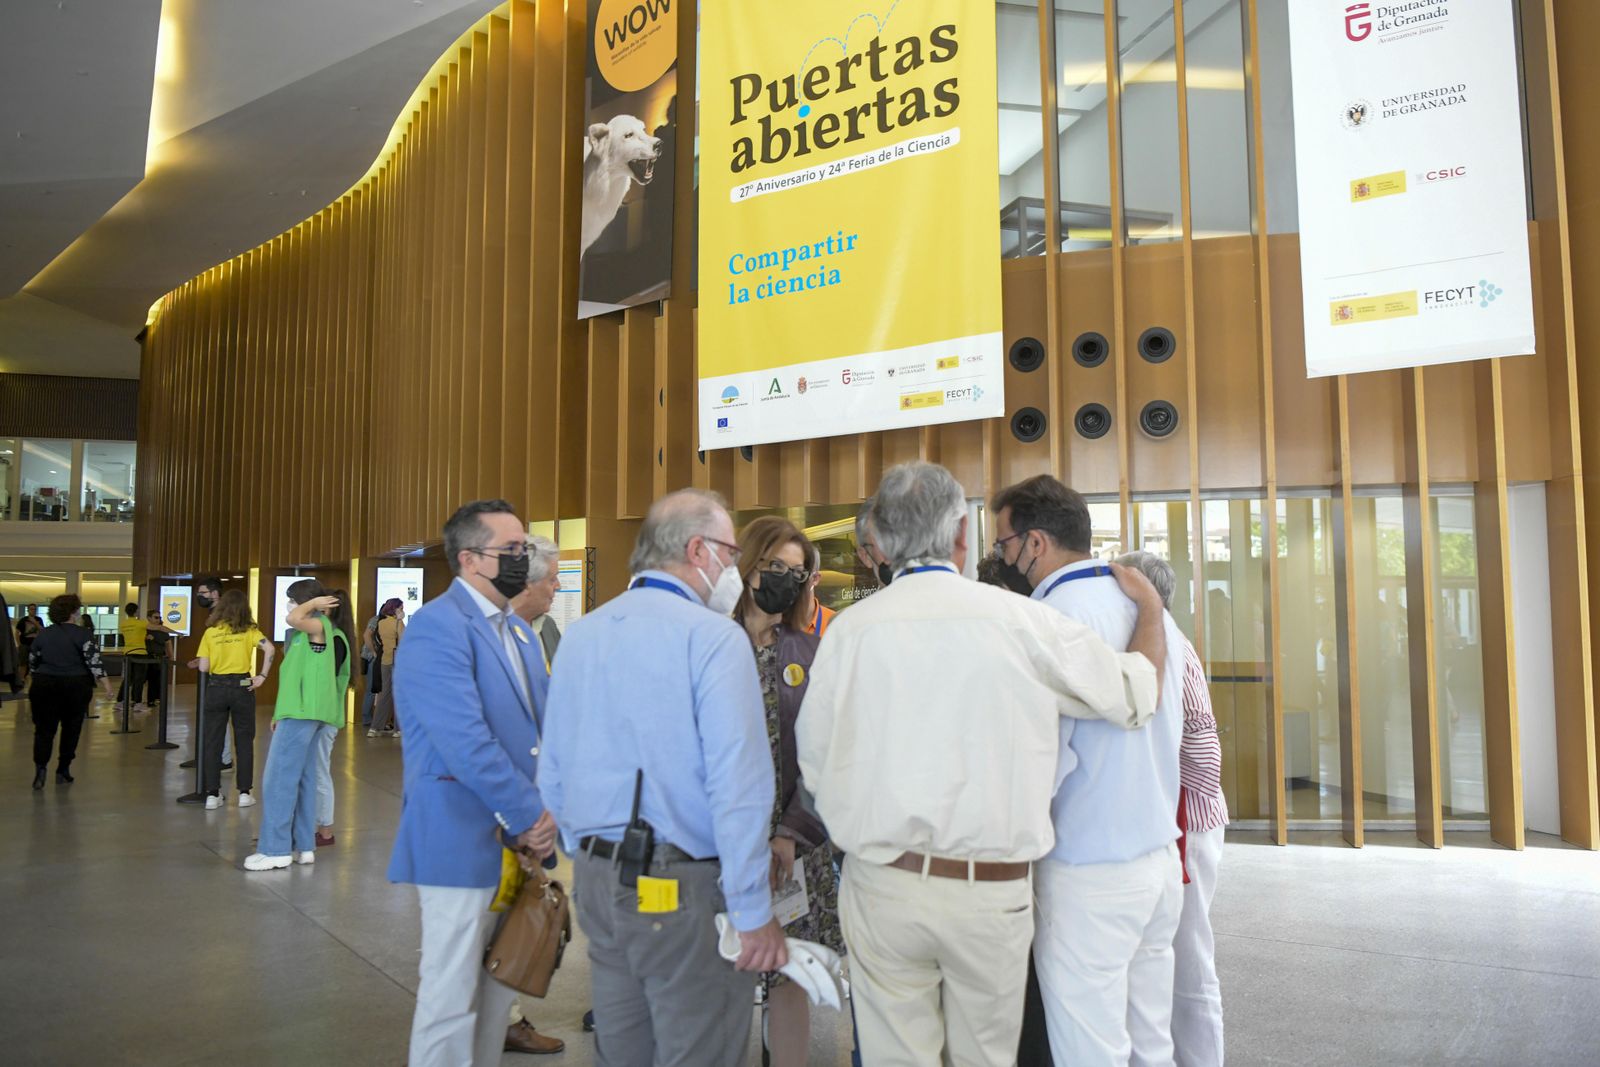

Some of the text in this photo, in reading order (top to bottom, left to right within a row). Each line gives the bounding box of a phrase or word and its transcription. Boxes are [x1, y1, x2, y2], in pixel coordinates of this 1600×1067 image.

[603, 0, 670, 51] WOW
[1377, 6, 1449, 32] de Granada
[730, 24, 959, 126] Puertas
[1382, 83, 1467, 108] UNIVERSIDAD
[1383, 108, 1398, 119] DE
[1399, 94, 1468, 116] GRANADA
[730, 77, 961, 174] abiertas
[756, 170, 816, 193] Aniversario
[819, 169, 826, 180] y
[848, 155, 876, 170] Feria
[878, 150, 892, 162] de
[894, 146, 904, 157] la
[907, 135, 951, 154] Ciencia
[1426, 166, 1467, 181] CSIC
[728, 230, 859, 276] Compartir
[728, 265, 842, 305] la ciencia
[1424, 286, 1476, 304] FECYT
[946, 388, 972, 398] FECYT
[841, 587, 854, 600] Canal
[854, 586, 861, 599] de
